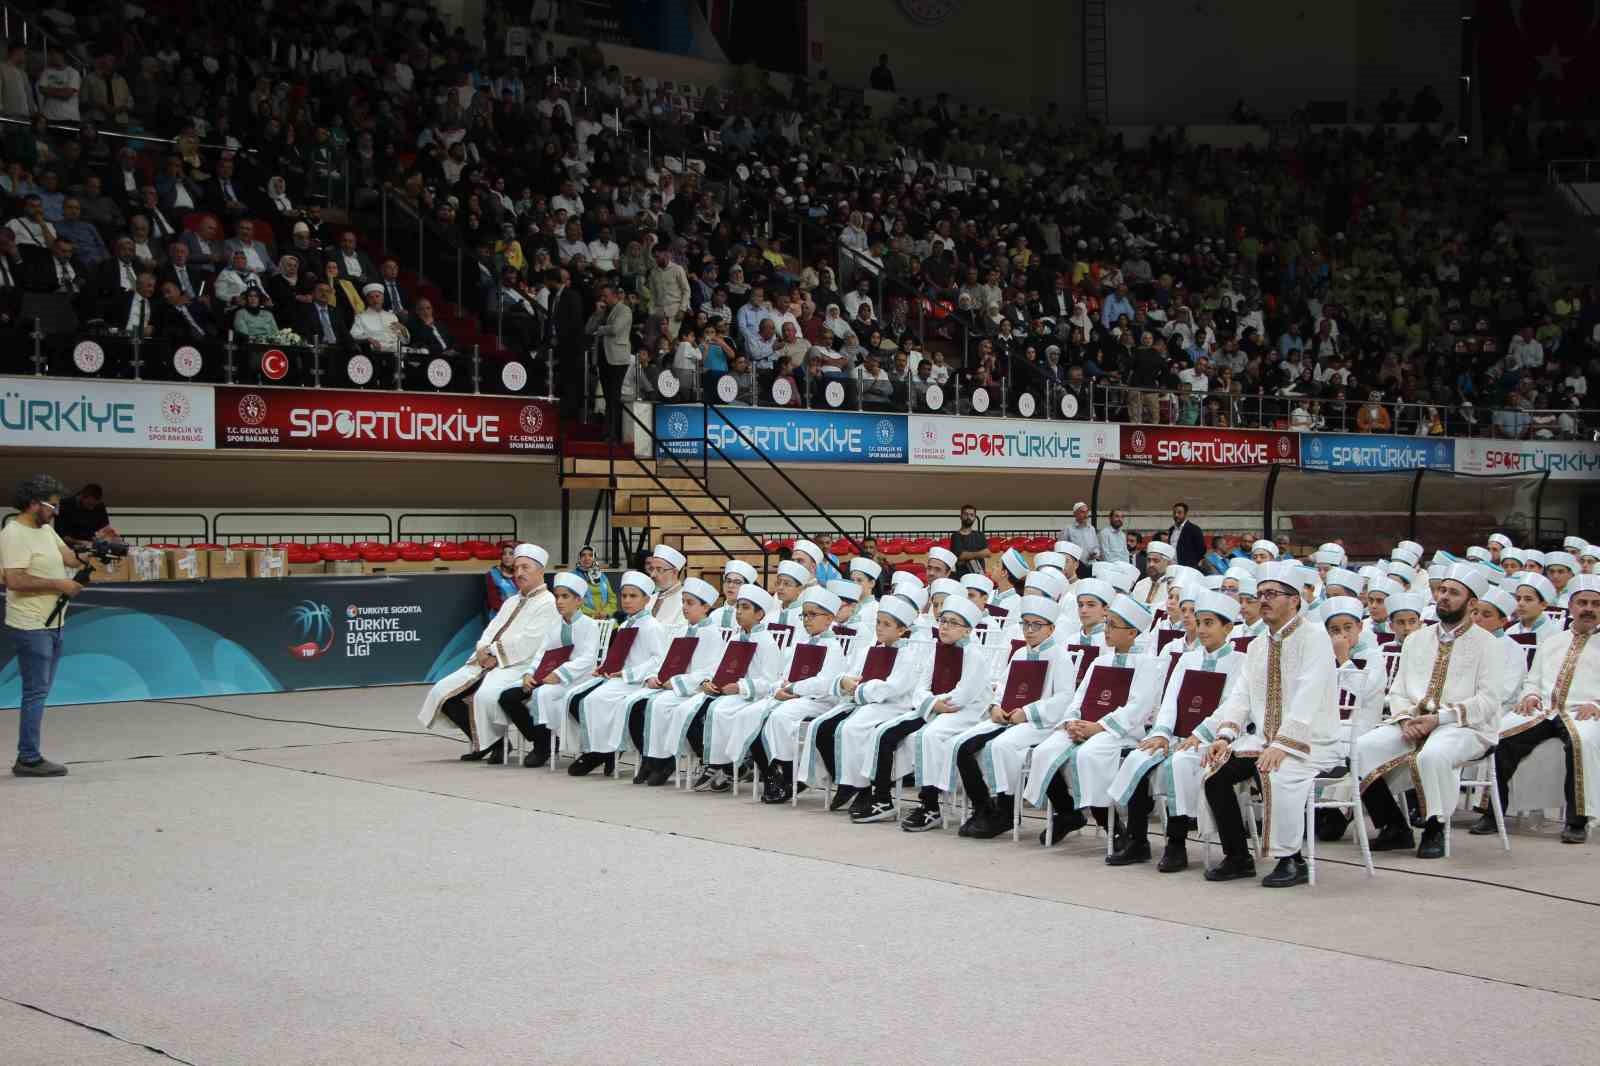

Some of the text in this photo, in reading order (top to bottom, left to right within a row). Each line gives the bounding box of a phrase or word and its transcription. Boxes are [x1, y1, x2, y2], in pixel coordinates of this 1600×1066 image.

[0, 391, 135, 433] ÜRKİYE
[289, 406, 500, 442] SPORTÜRKİYE
[706, 421, 862, 453] SPORTÜRKİYE
[951, 430, 1081, 459] SPORTÜRKİYE
[1157, 438, 1268, 464] SPORTÜRKİYE
[1331, 444, 1426, 468] SPORTÜRKİYE
[1485, 450, 1600, 471] SPORTÜRKİY
[346, 616, 400, 631] TÜRKİYE
[346, 630, 421, 644] BASKETBOL
[346, 643, 370, 657] LİGİ
